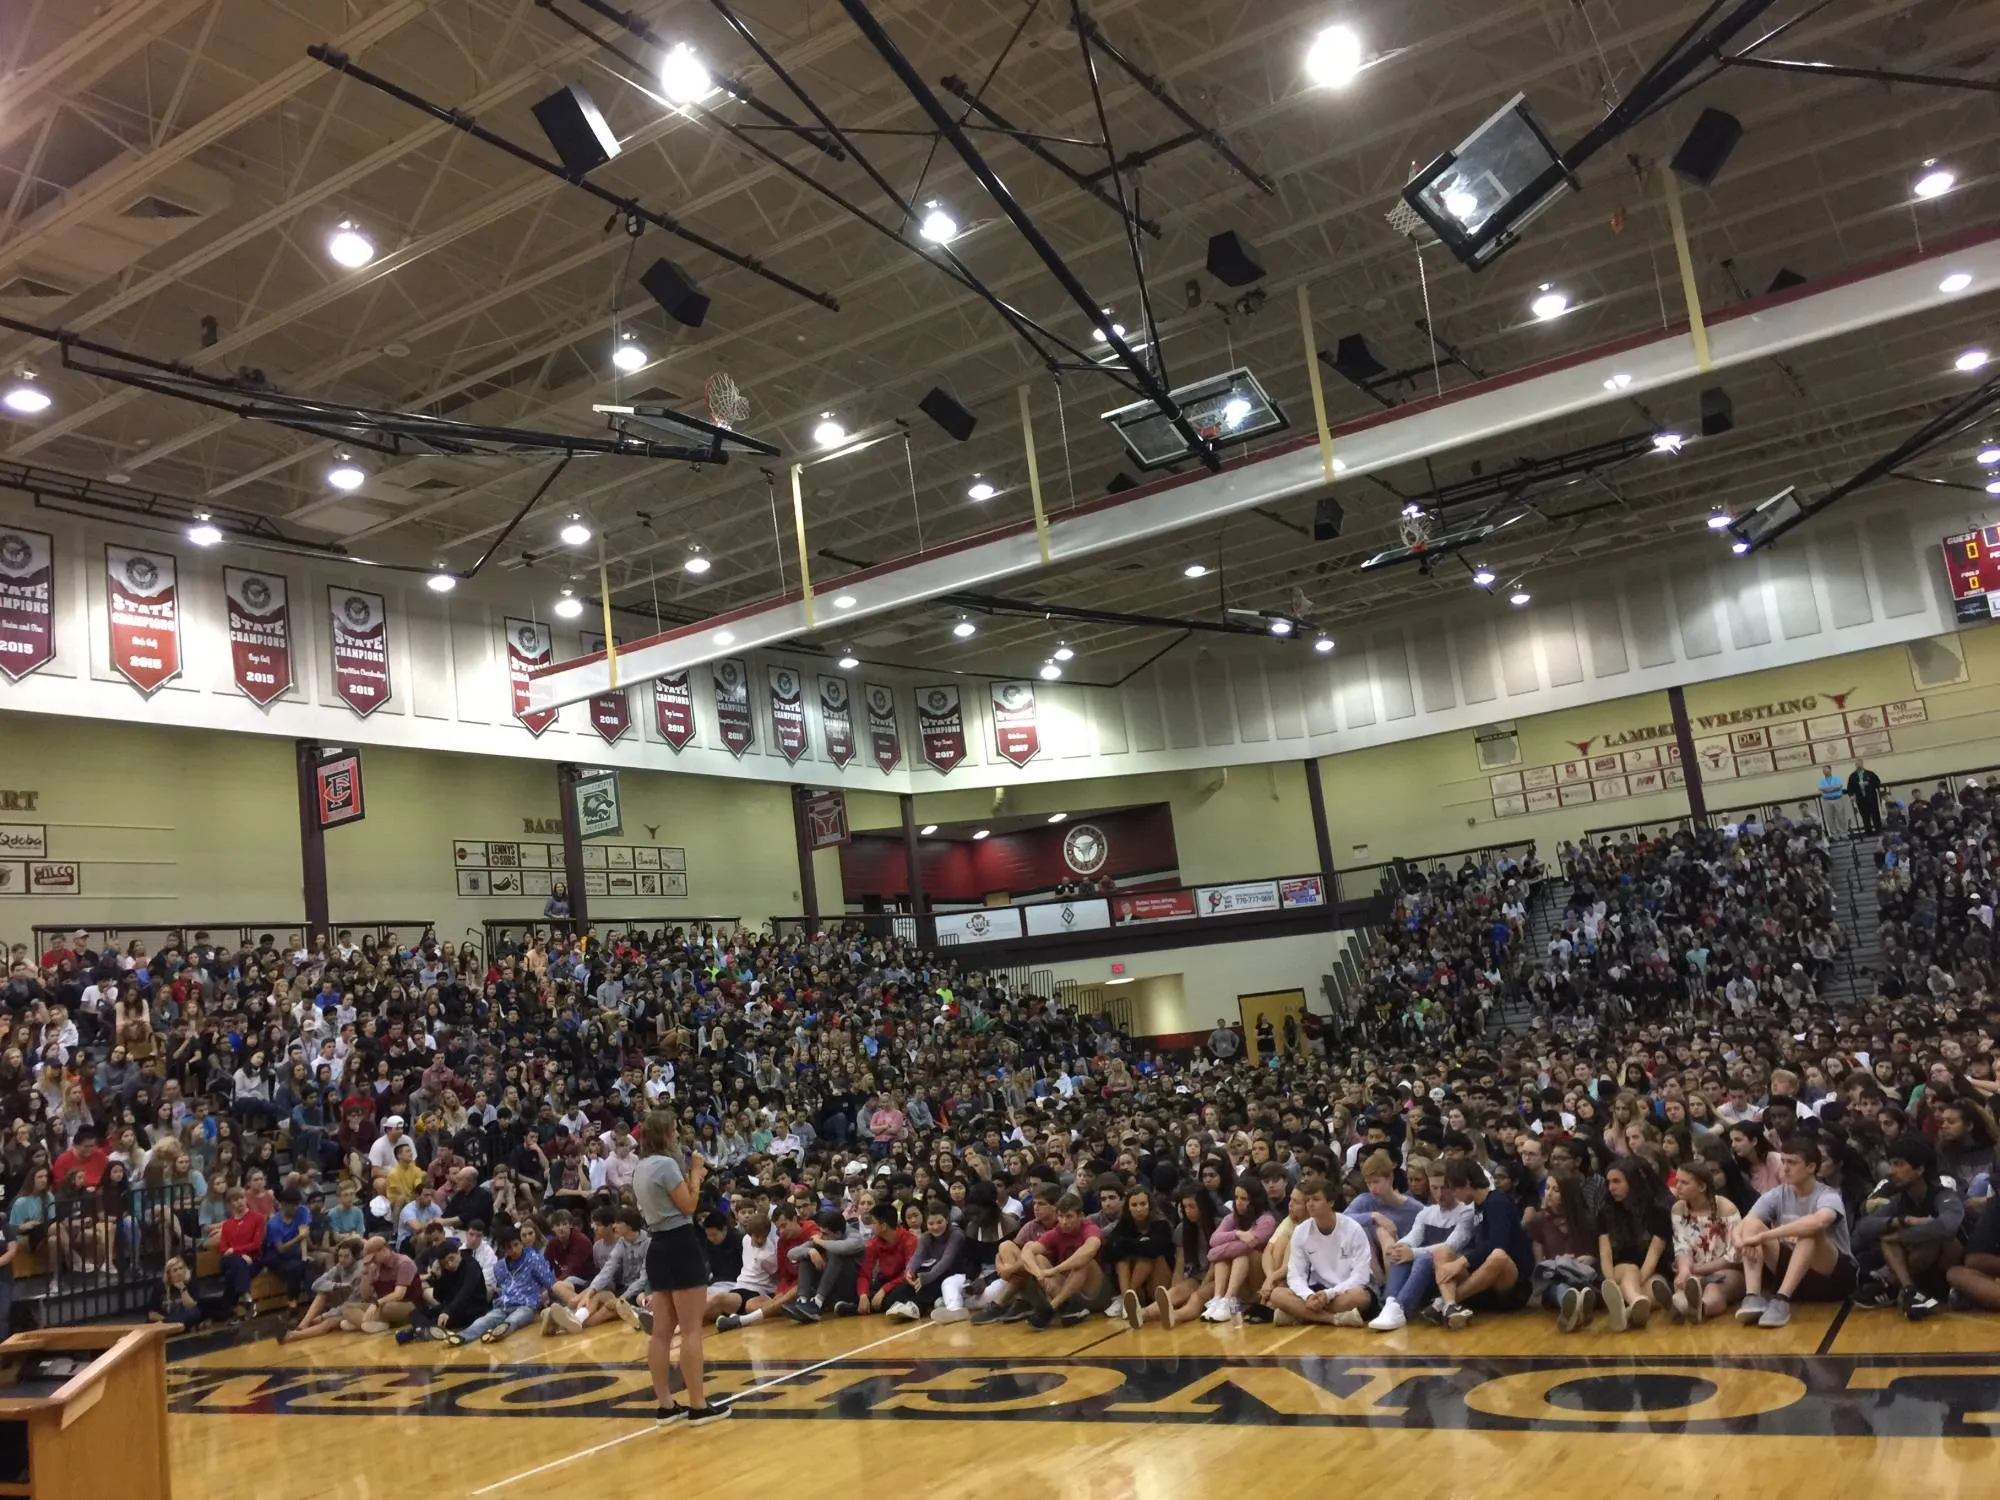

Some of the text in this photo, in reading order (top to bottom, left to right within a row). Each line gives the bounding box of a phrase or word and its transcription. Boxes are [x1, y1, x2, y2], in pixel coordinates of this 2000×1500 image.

[1947, 532, 1977, 544] GUEST
[1966, 542, 1979, 559] 0
[1968, 576, 1979, 589] 0
[113, 593, 174, 617] STATE
[231, 612, 284, 634] STATE
[231, 631, 286, 648] CHAMPIONS
[335, 630, 382, 650] STATE
[0, 640, 34, 655] 2015
[335, 646, 384, 662] CHAMPIONS
[246, 671, 275, 684] 2015
[349, 684, 374, 696] 2015
[656, 680, 687, 696] STATE
[656, 694, 689, 705] CHAMPIONS
[717, 702, 748, 713] CHAMPIONS
[774, 701, 801, 713] STATE
[774, 711, 802, 722] CHAMPIONS
[824, 709, 848, 721] STATE
[871, 716, 894, 727] STATE
[922, 716, 960, 727] STATE
[1604, 717, 1694, 748] LAMBE
[1696, 695, 1818, 730] WRESTLING
[922, 726, 961, 735] CHAMPIONS
[1740, 733, 1760, 744] DLP
[935, 750, 955, 759] 2017
[0, 832, 42, 849] Qdoba
[491, 844, 515, 855] LENNYS
[500, 855, 516, 866] SUBS
[34, 865, 74, 878] WILCO
